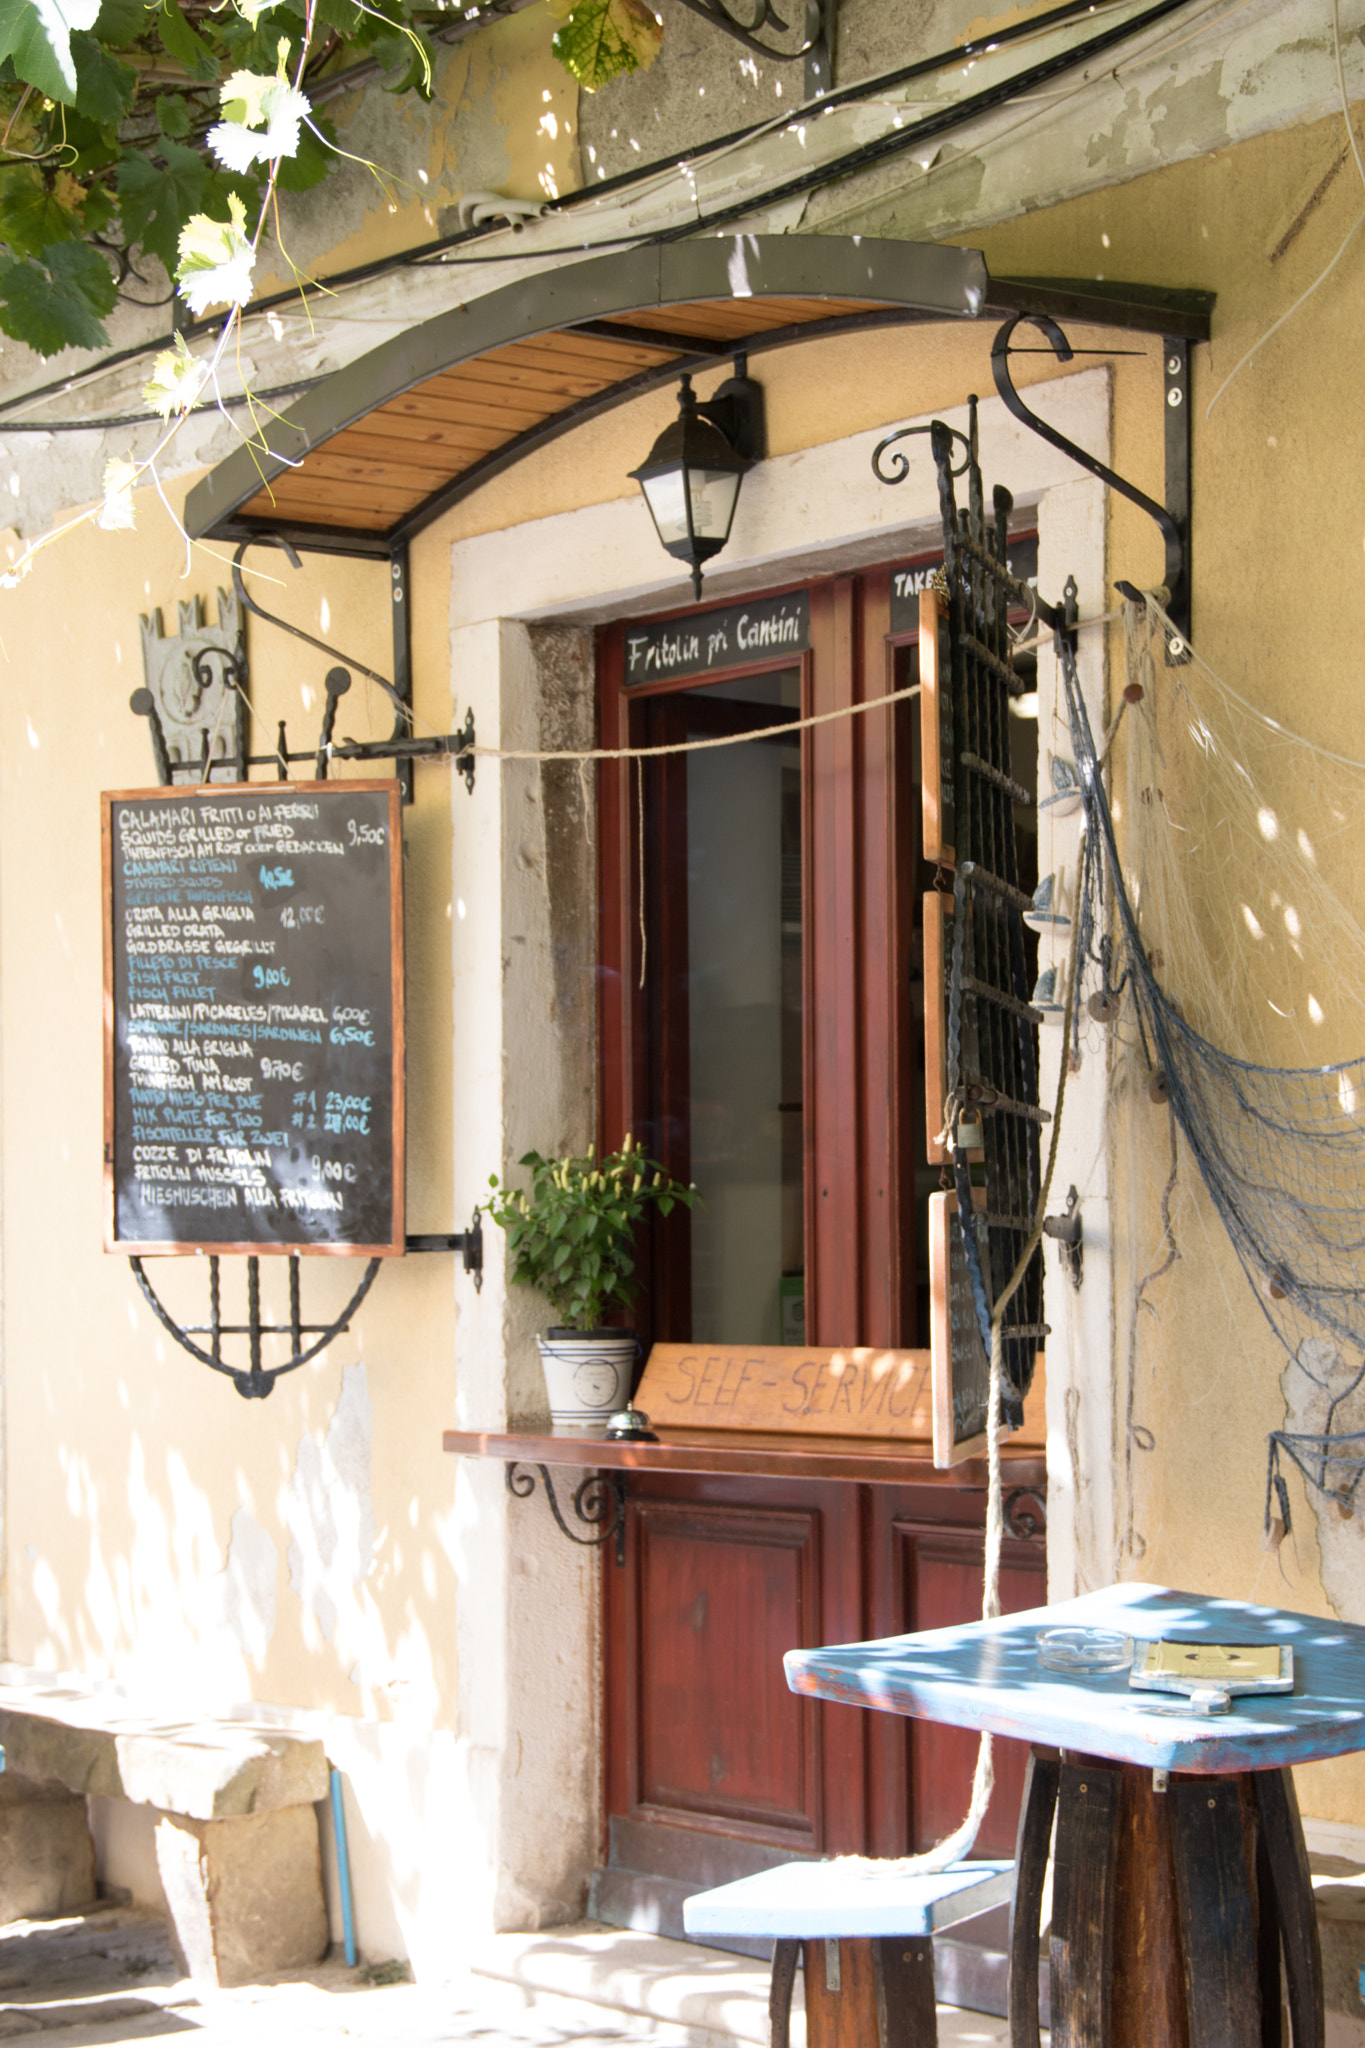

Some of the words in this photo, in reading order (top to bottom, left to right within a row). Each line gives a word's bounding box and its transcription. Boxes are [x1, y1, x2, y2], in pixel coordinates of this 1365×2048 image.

[628, 636, 699, 671] Fritolin
[118, 806, 196, 831] CALAMARI
[200, 805, 243, 824] FRITTI
[120, 829, 176, 847] SQUIDS
[178, 826, 235, 845] GRILLED
[253, 823, 295, 843] FRIED
[197, 842, 214, 859] AM
[123, 859, 185, 876] CALAMARI
[124, 876, 178, 890] STUFFED
[179, 876, 223, 889] SQUIDS
[125, 905, 165, 922] ORATA
[167, 905, 201, 922] ALLA
[202, 904, 256, 923] GRIGLIA
[125, 922, 180, 938] GRILLED
[182, 923, 226, 938] ORATA
[125, 938, 211, 955] GOLDBRASSE
[177, 956, 193, 970] DI
[195, 954, 239, 971] PESCE
[127, 970, 162, 986] FISH
[127, 985, 169, 1004] FISCH
[171, 986, 217, 1002] FILLET
[329, 1026, 376, 1048] 6,50€
[172, 1038, 201, 1057] ALLA
[203, 1039, 254, 1059] GRIGLIA
[128, 1054, 181, 1075] GRILLED
[182, 1055, 220, 1075] TUNA
[201, 1073, 222, 1091] AM
[222, 1074, 253, 1093] ROST
[205, 1091, 235, 1110] PER
[235, 1093, 264, 1111] DUE
[132, 1106, 159, 1125] MIX
[162, 1106, 203, 1126] PLATE
[231, 1111, 264, 1130] TWO
[249, 1129, 289, 1149] ZWEI
[132, 1145, 180, 1162] COZZE
[185, 1146, 203, 1164] DI
[195, 1163, 268, 1188] MUSSELS
[243, 1185, 279, 1208] ALLA
